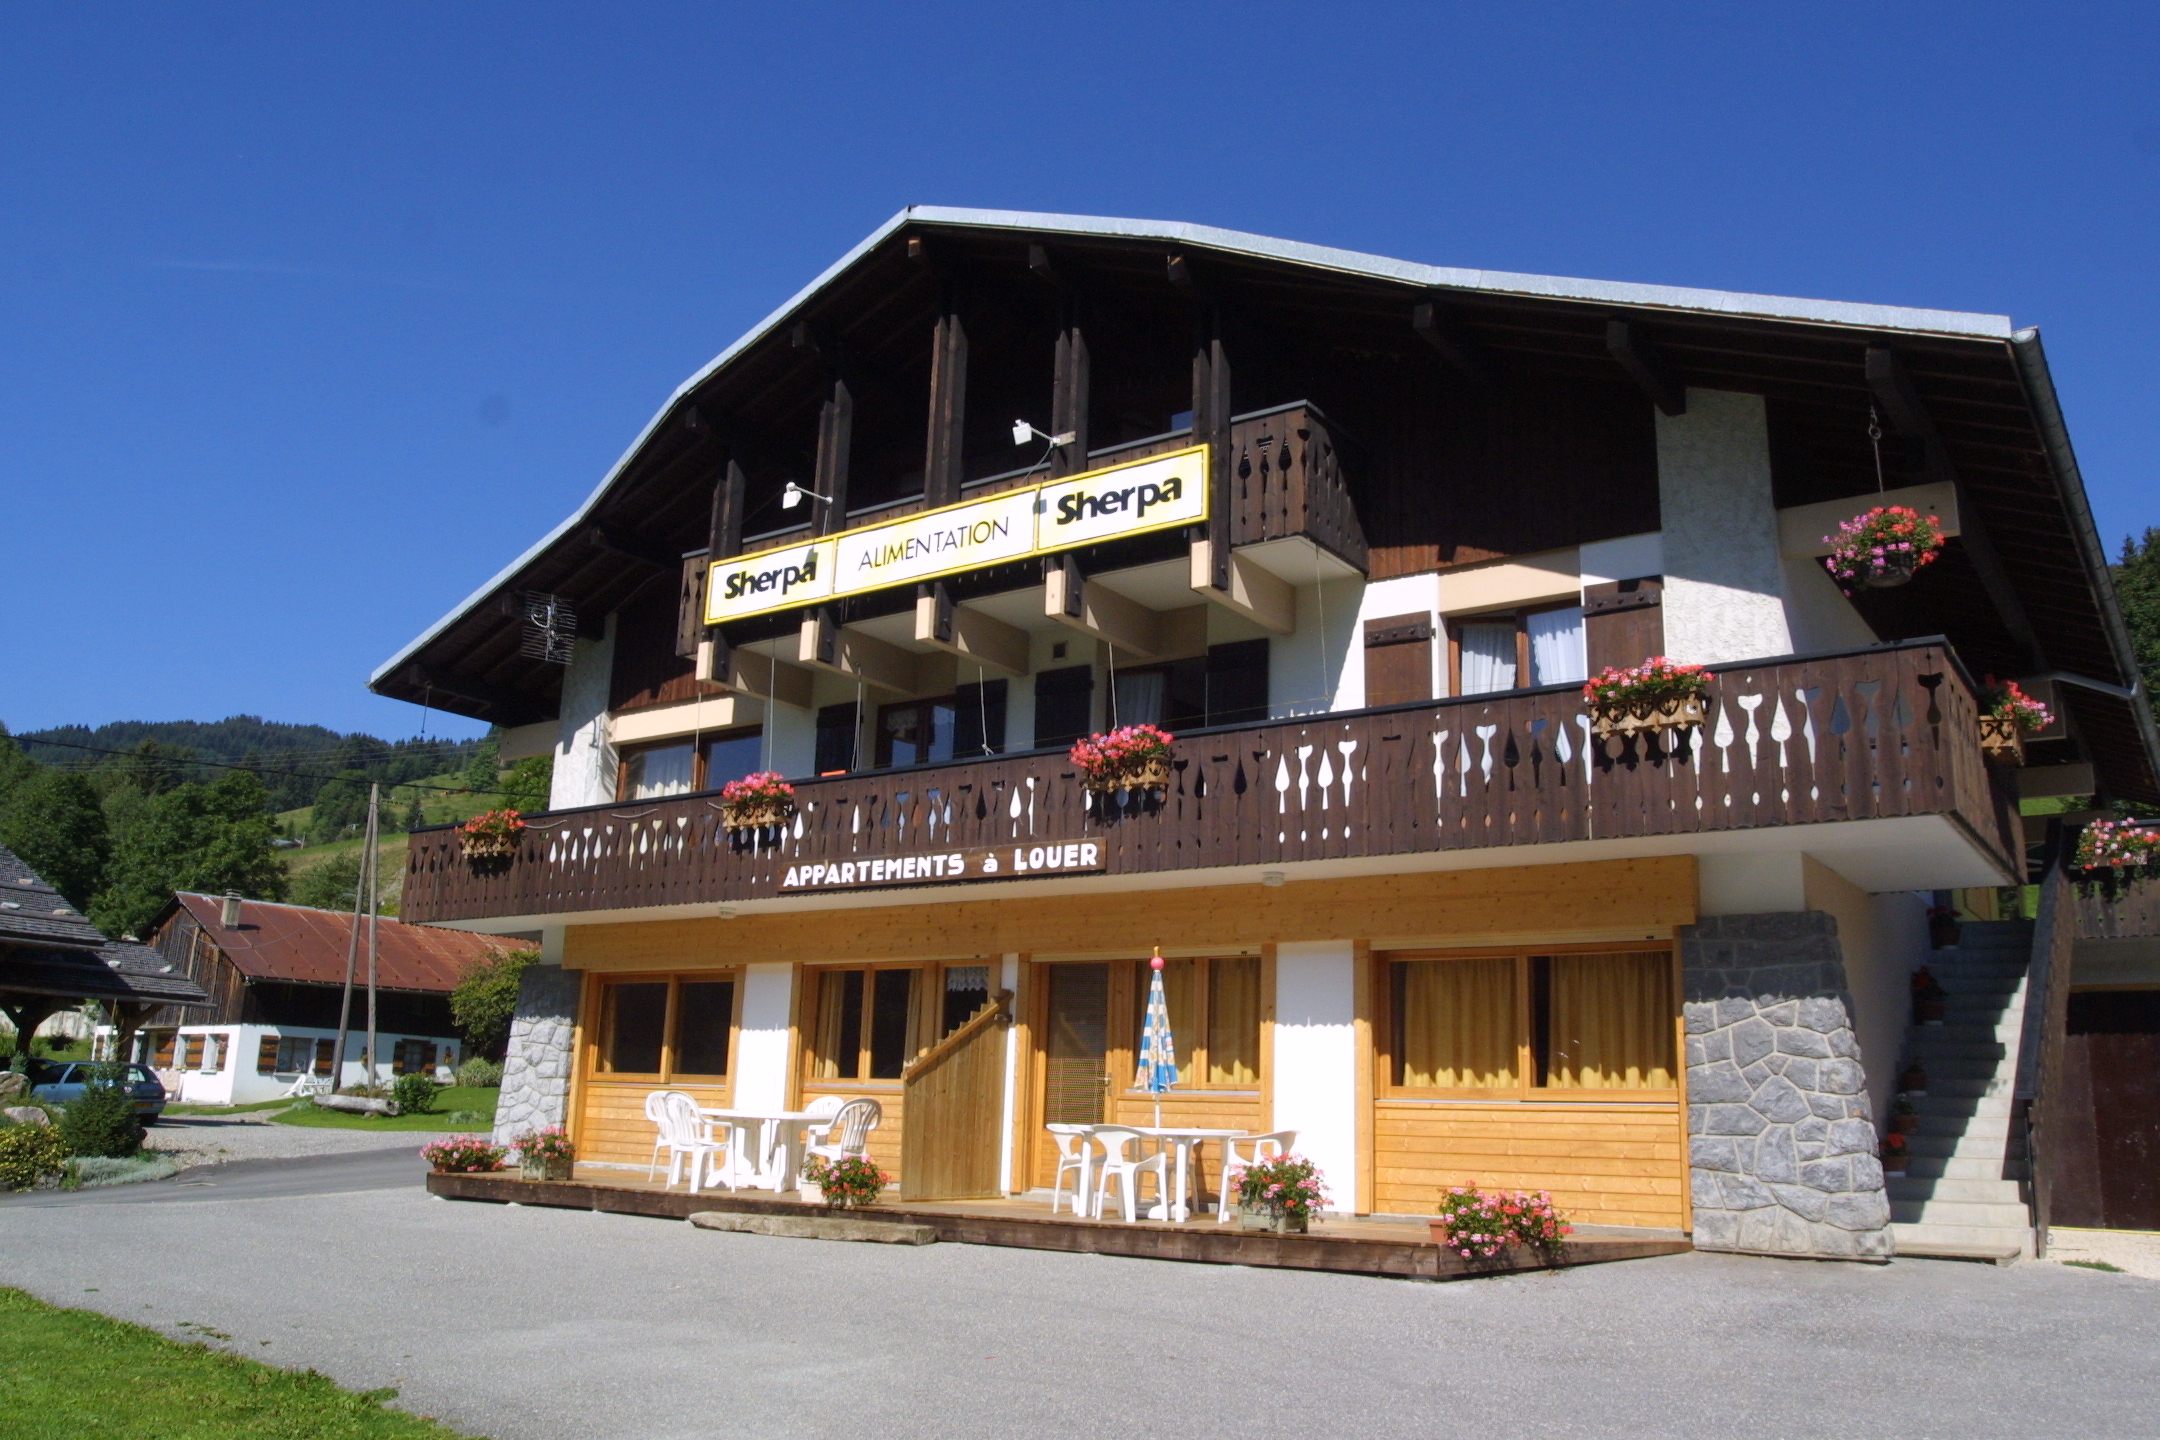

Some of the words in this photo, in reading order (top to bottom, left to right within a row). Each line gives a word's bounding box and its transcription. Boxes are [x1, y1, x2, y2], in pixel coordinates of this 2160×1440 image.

[1058, 478, 1181, 525] Sherpa
[859, 517, 1009, 571] ALIMENTATION
[725, 561, 817, 600] Sherpa
[782, 853, 965, 887] APPARTEMENTS
[983, 852, 998, 873] à
[1014, 843, 1098, 871] LOUER
